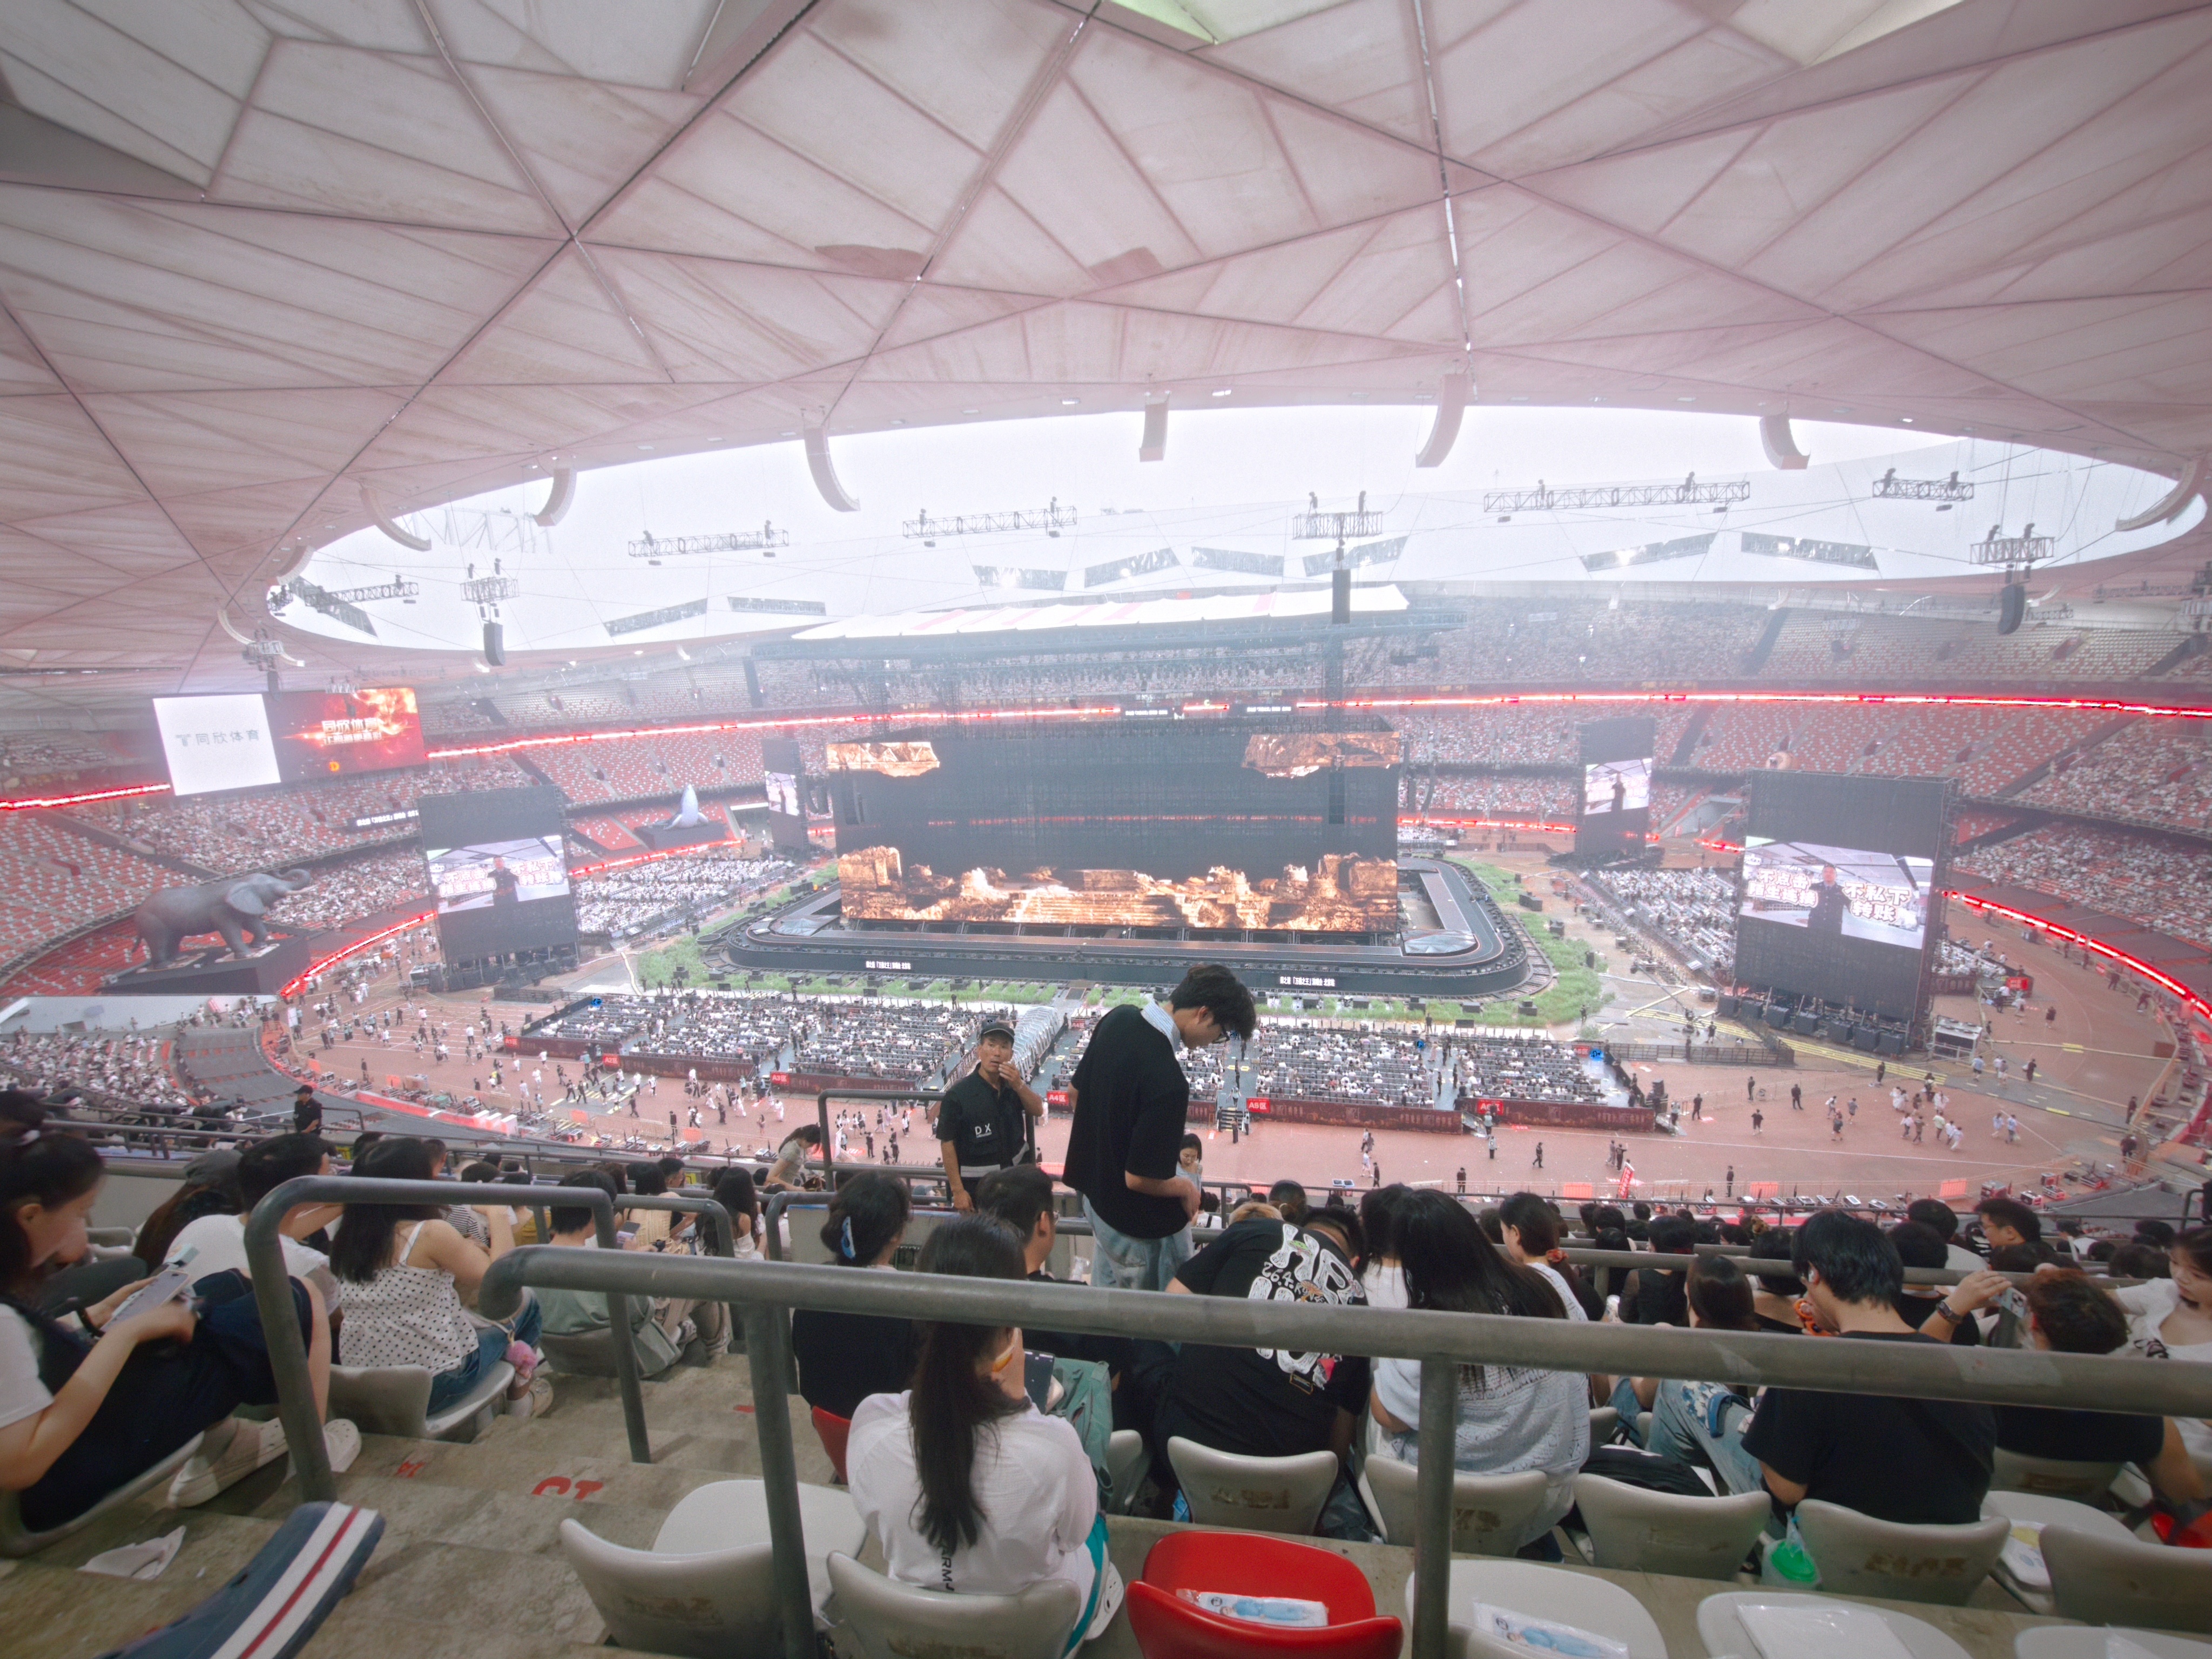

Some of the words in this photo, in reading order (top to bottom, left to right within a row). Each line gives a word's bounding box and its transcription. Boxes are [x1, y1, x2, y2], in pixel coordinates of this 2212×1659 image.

[1758, 869, 1809, 890] 不点击
[1842, 881, 1911, 906] 不私下
[1851, 901, 1897, 922] 转账
[772, 1074, 787, 1082] A3区
[1049, 1094, 1066, 1102] A4区
[1249, 1102, 1267, 1110] A5区
